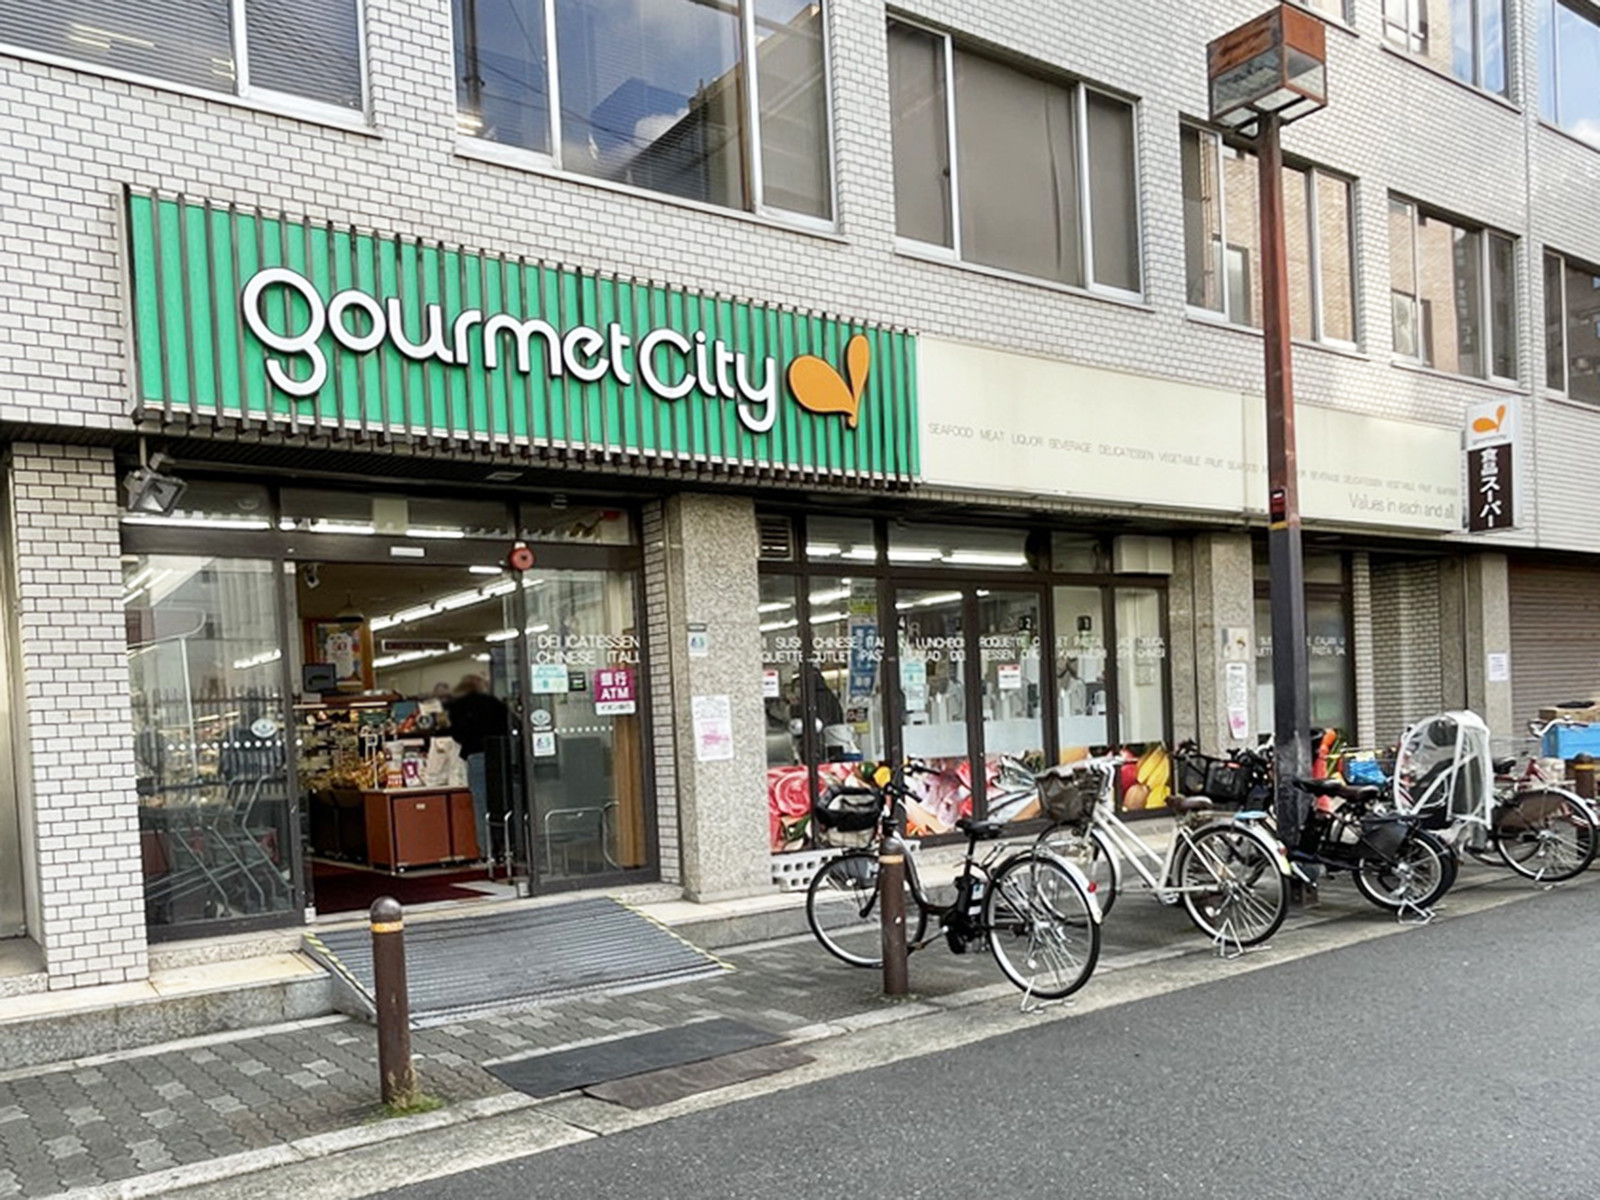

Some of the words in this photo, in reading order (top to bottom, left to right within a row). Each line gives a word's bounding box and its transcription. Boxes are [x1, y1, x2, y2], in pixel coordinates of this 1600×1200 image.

[927, 422, 974, 439] SEAFOOD
[979, 428, 1005, 443] MEAT
[1011, 433, 1044, 447] LIQUOR
[1479, 446, 1502, 528] 食品スーパー
[1348, 492, 1385, 512] Values
[537, 634, 640, 649] DELICATESSEN
[536, 650, 597, 665] CHINESE
[600, 671, 627, 687] 銀行
[600, 687, 630, 700] ATM
